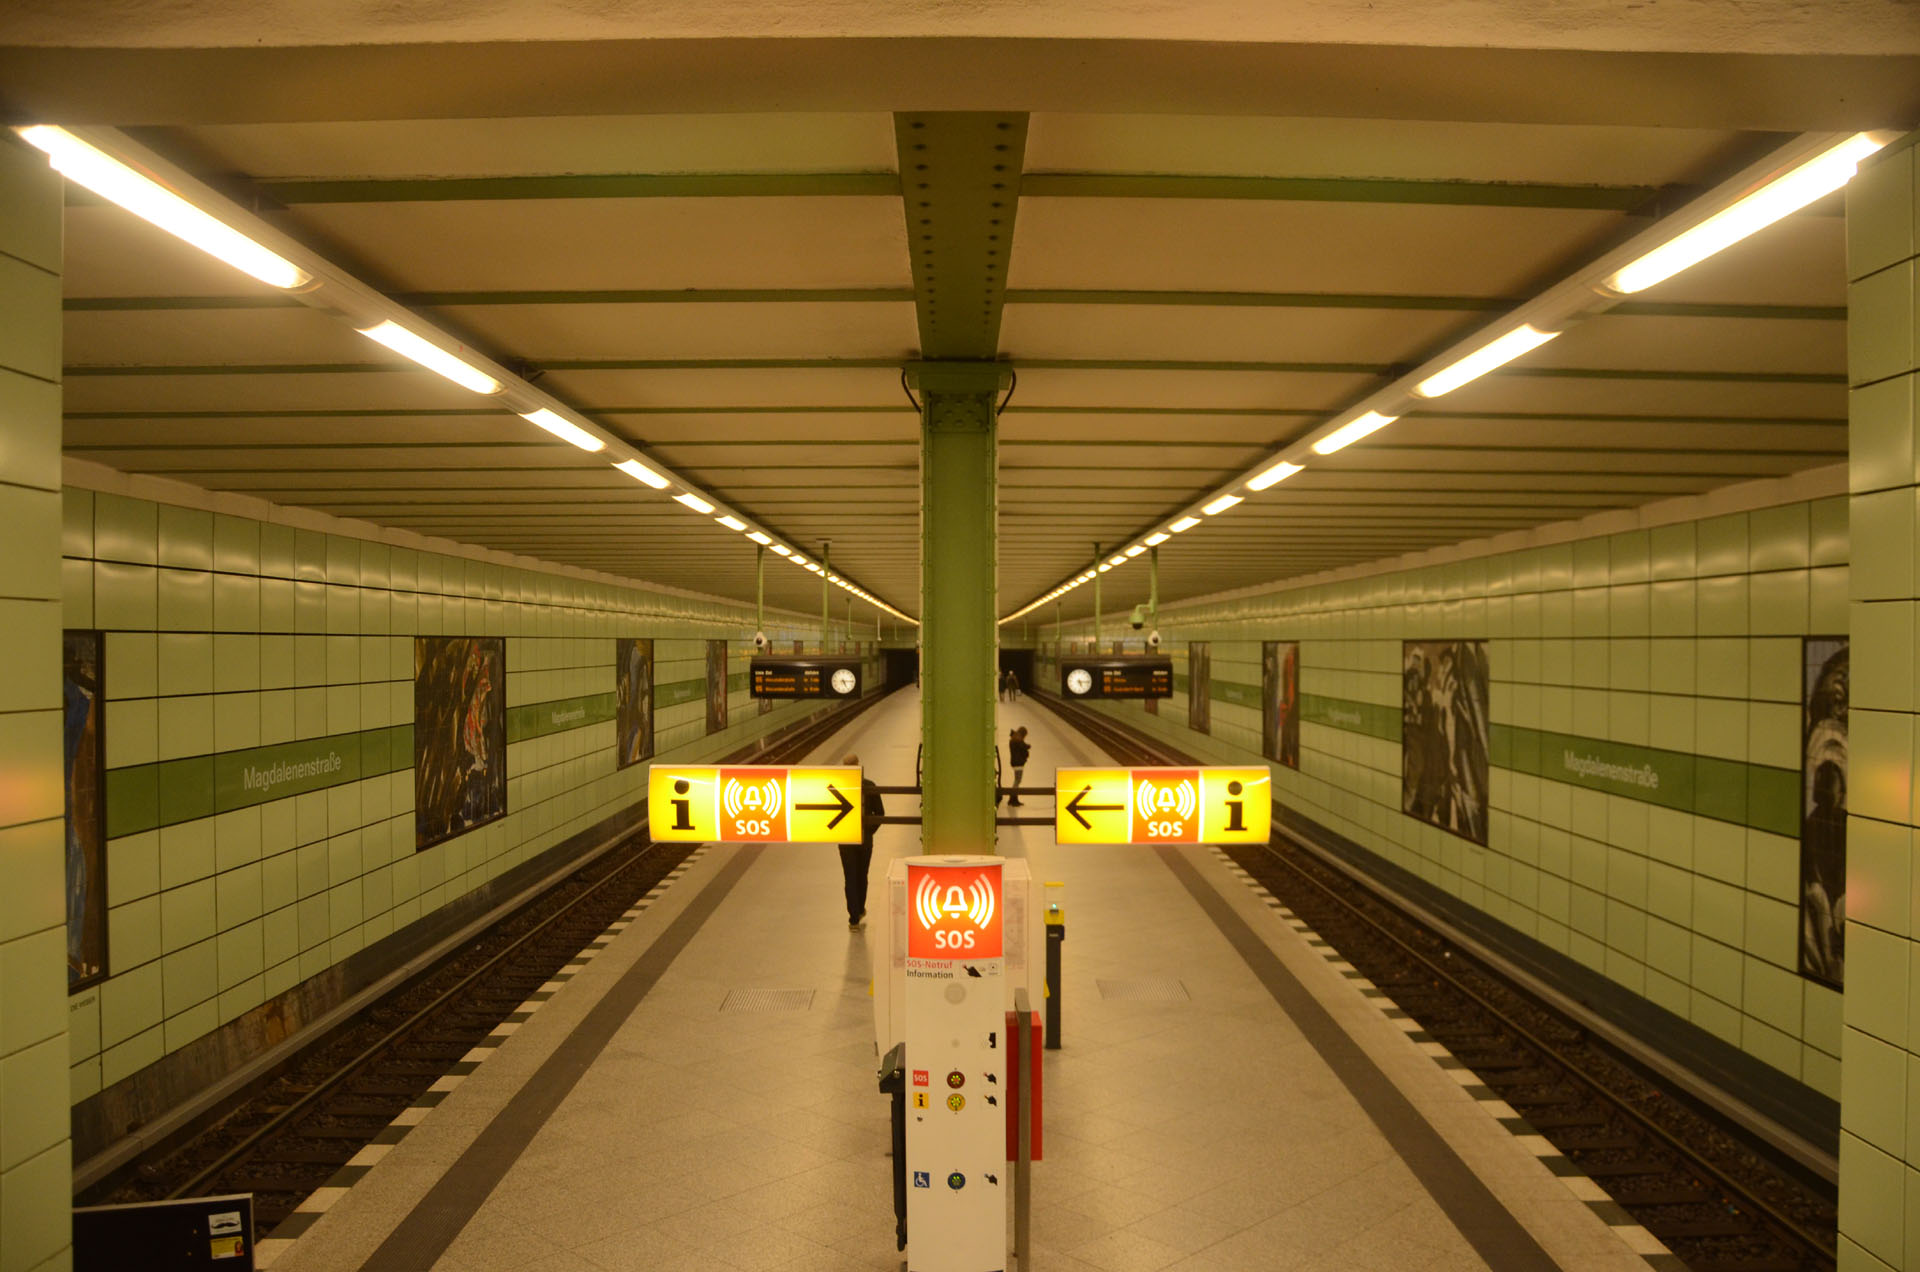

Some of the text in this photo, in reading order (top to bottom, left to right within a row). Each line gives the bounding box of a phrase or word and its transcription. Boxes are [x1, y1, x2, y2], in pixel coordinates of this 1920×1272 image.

[244, 752, 341, 792] Magdalenenstraße
[736, 820, 770, 835] SOS
[1148, 821, 1183, 837] SOS
[935, 930, 975, 949] SOS
[906, 960, 953, 969] SOS-Notruf
[906, 969, 954, 979] Information
[914, 1074, 928, 1082] SOS
